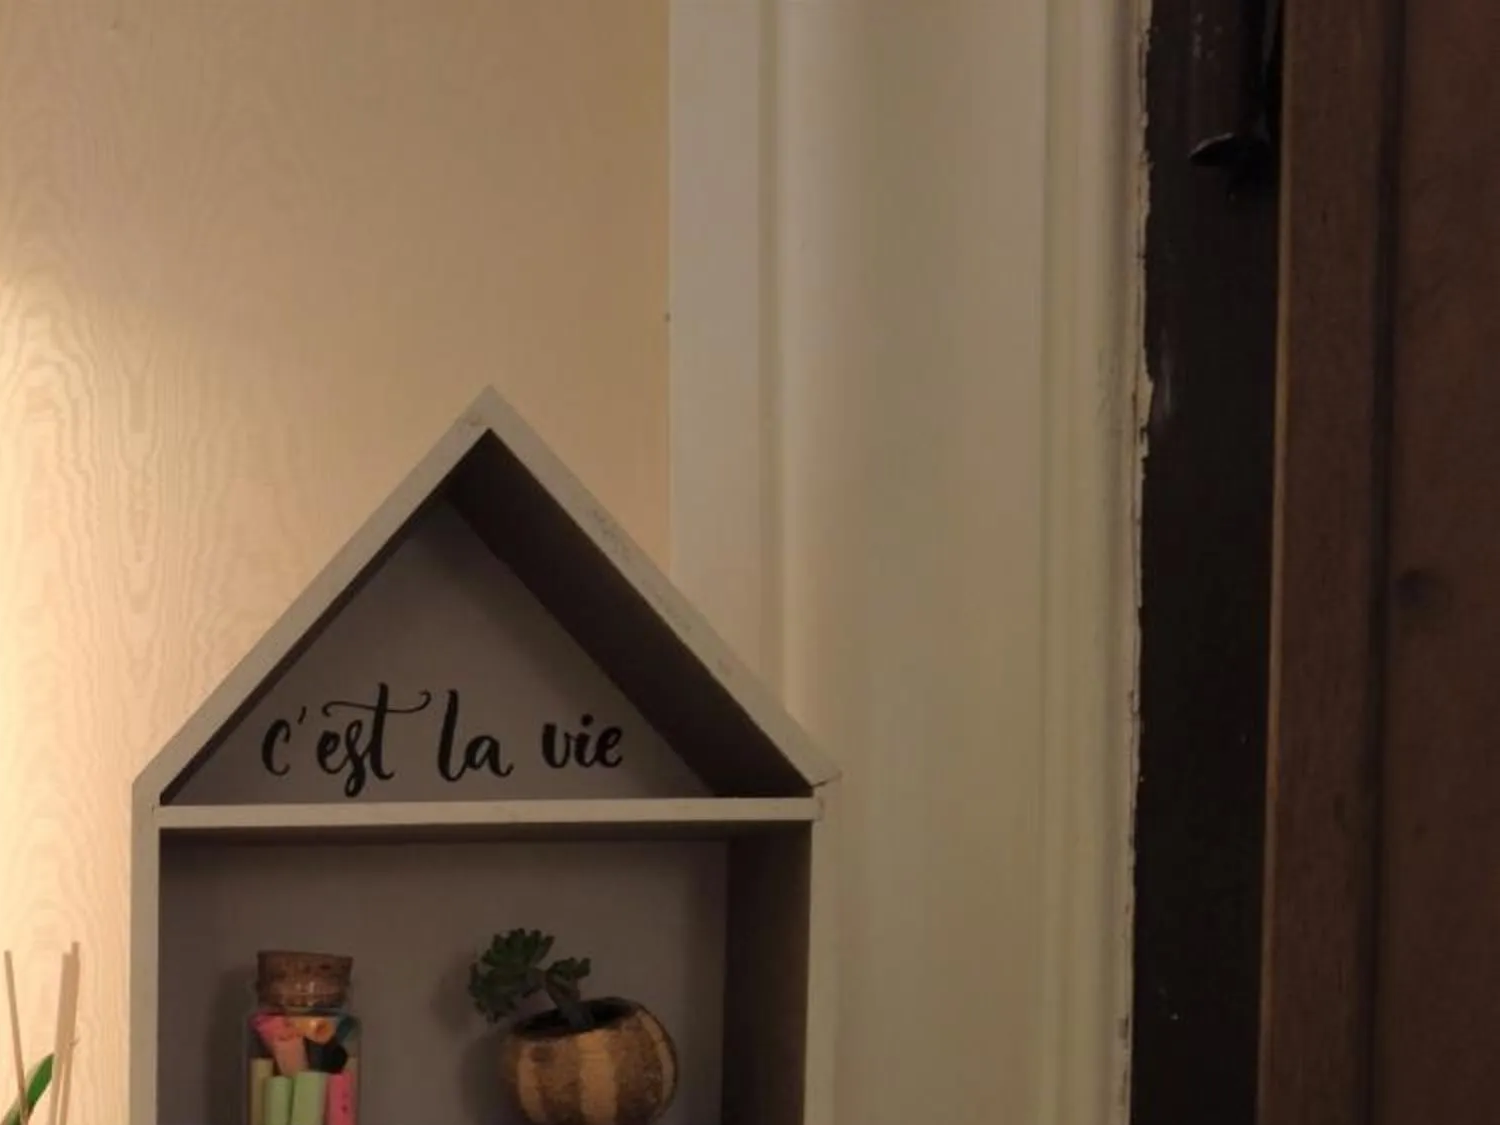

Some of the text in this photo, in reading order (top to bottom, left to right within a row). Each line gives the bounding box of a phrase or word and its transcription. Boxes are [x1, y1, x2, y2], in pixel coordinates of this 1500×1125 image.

[261, 682, 623, 798] c'est la vie
